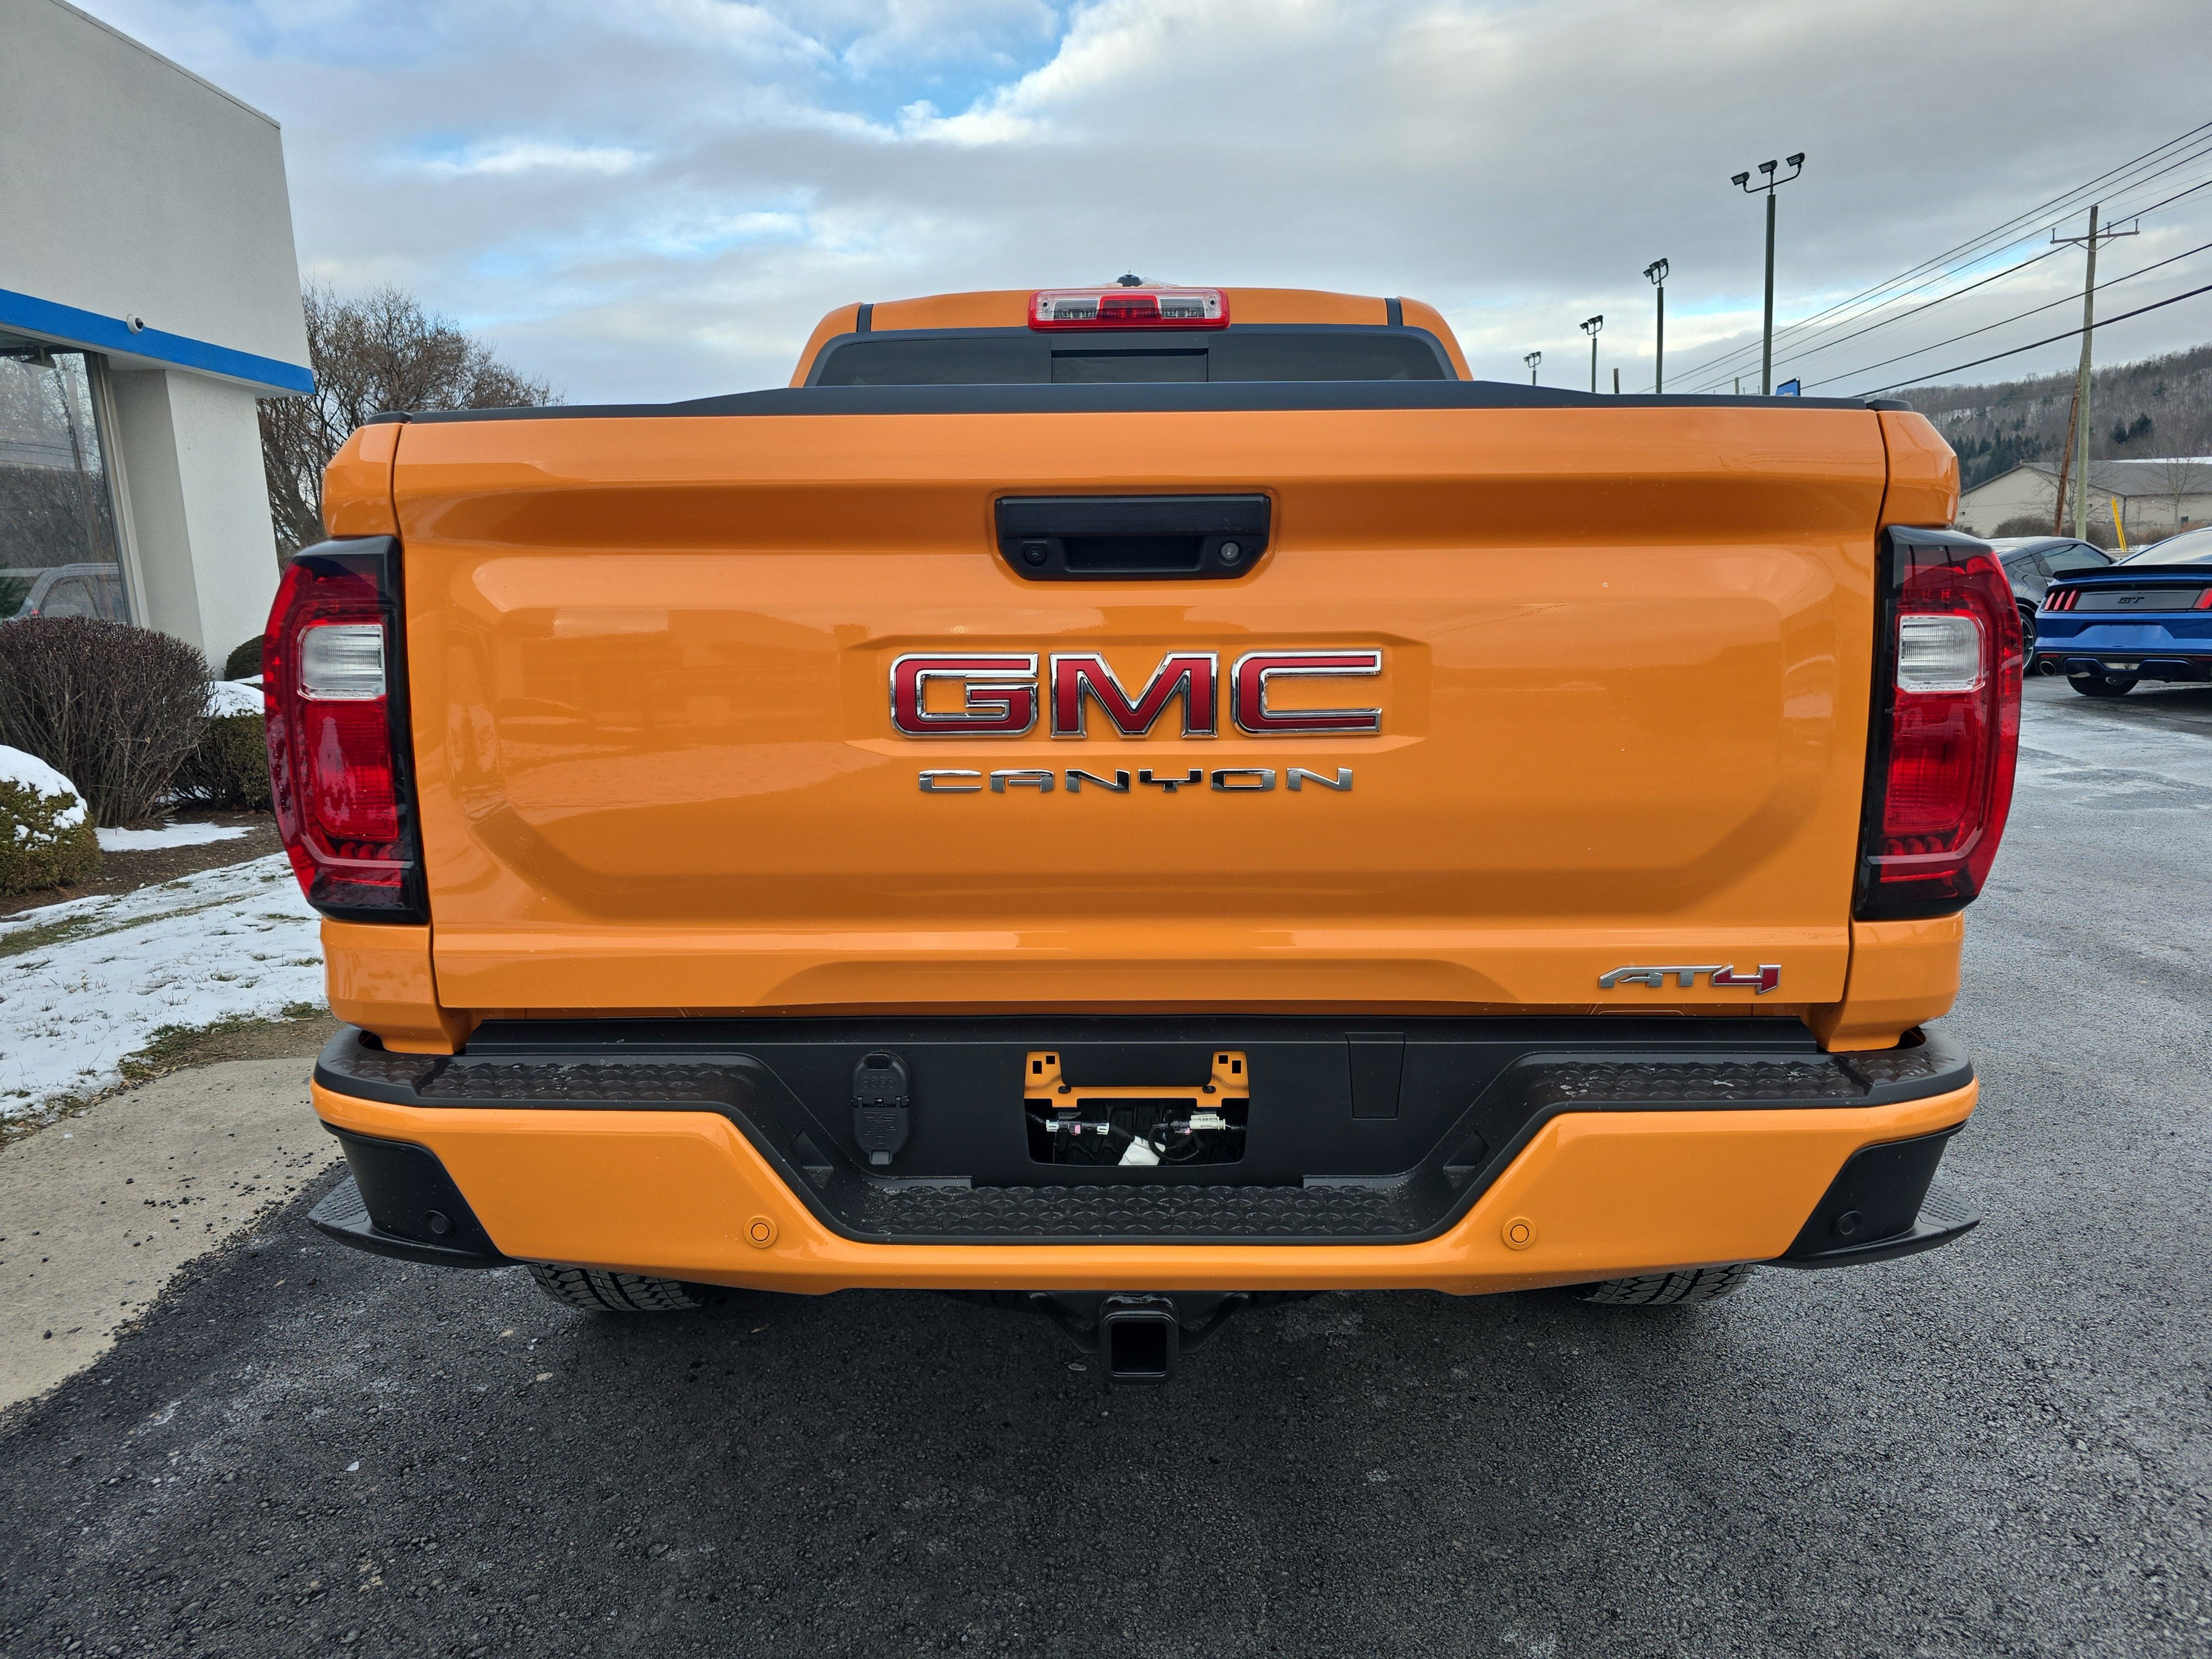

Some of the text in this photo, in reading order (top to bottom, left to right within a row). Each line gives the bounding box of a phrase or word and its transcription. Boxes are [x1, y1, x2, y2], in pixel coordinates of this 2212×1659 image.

[890, 649, 1383, 738] GMC
[918, 767, 1353, 793] CANYON
[1599, 964, 1781, 994] AT4
